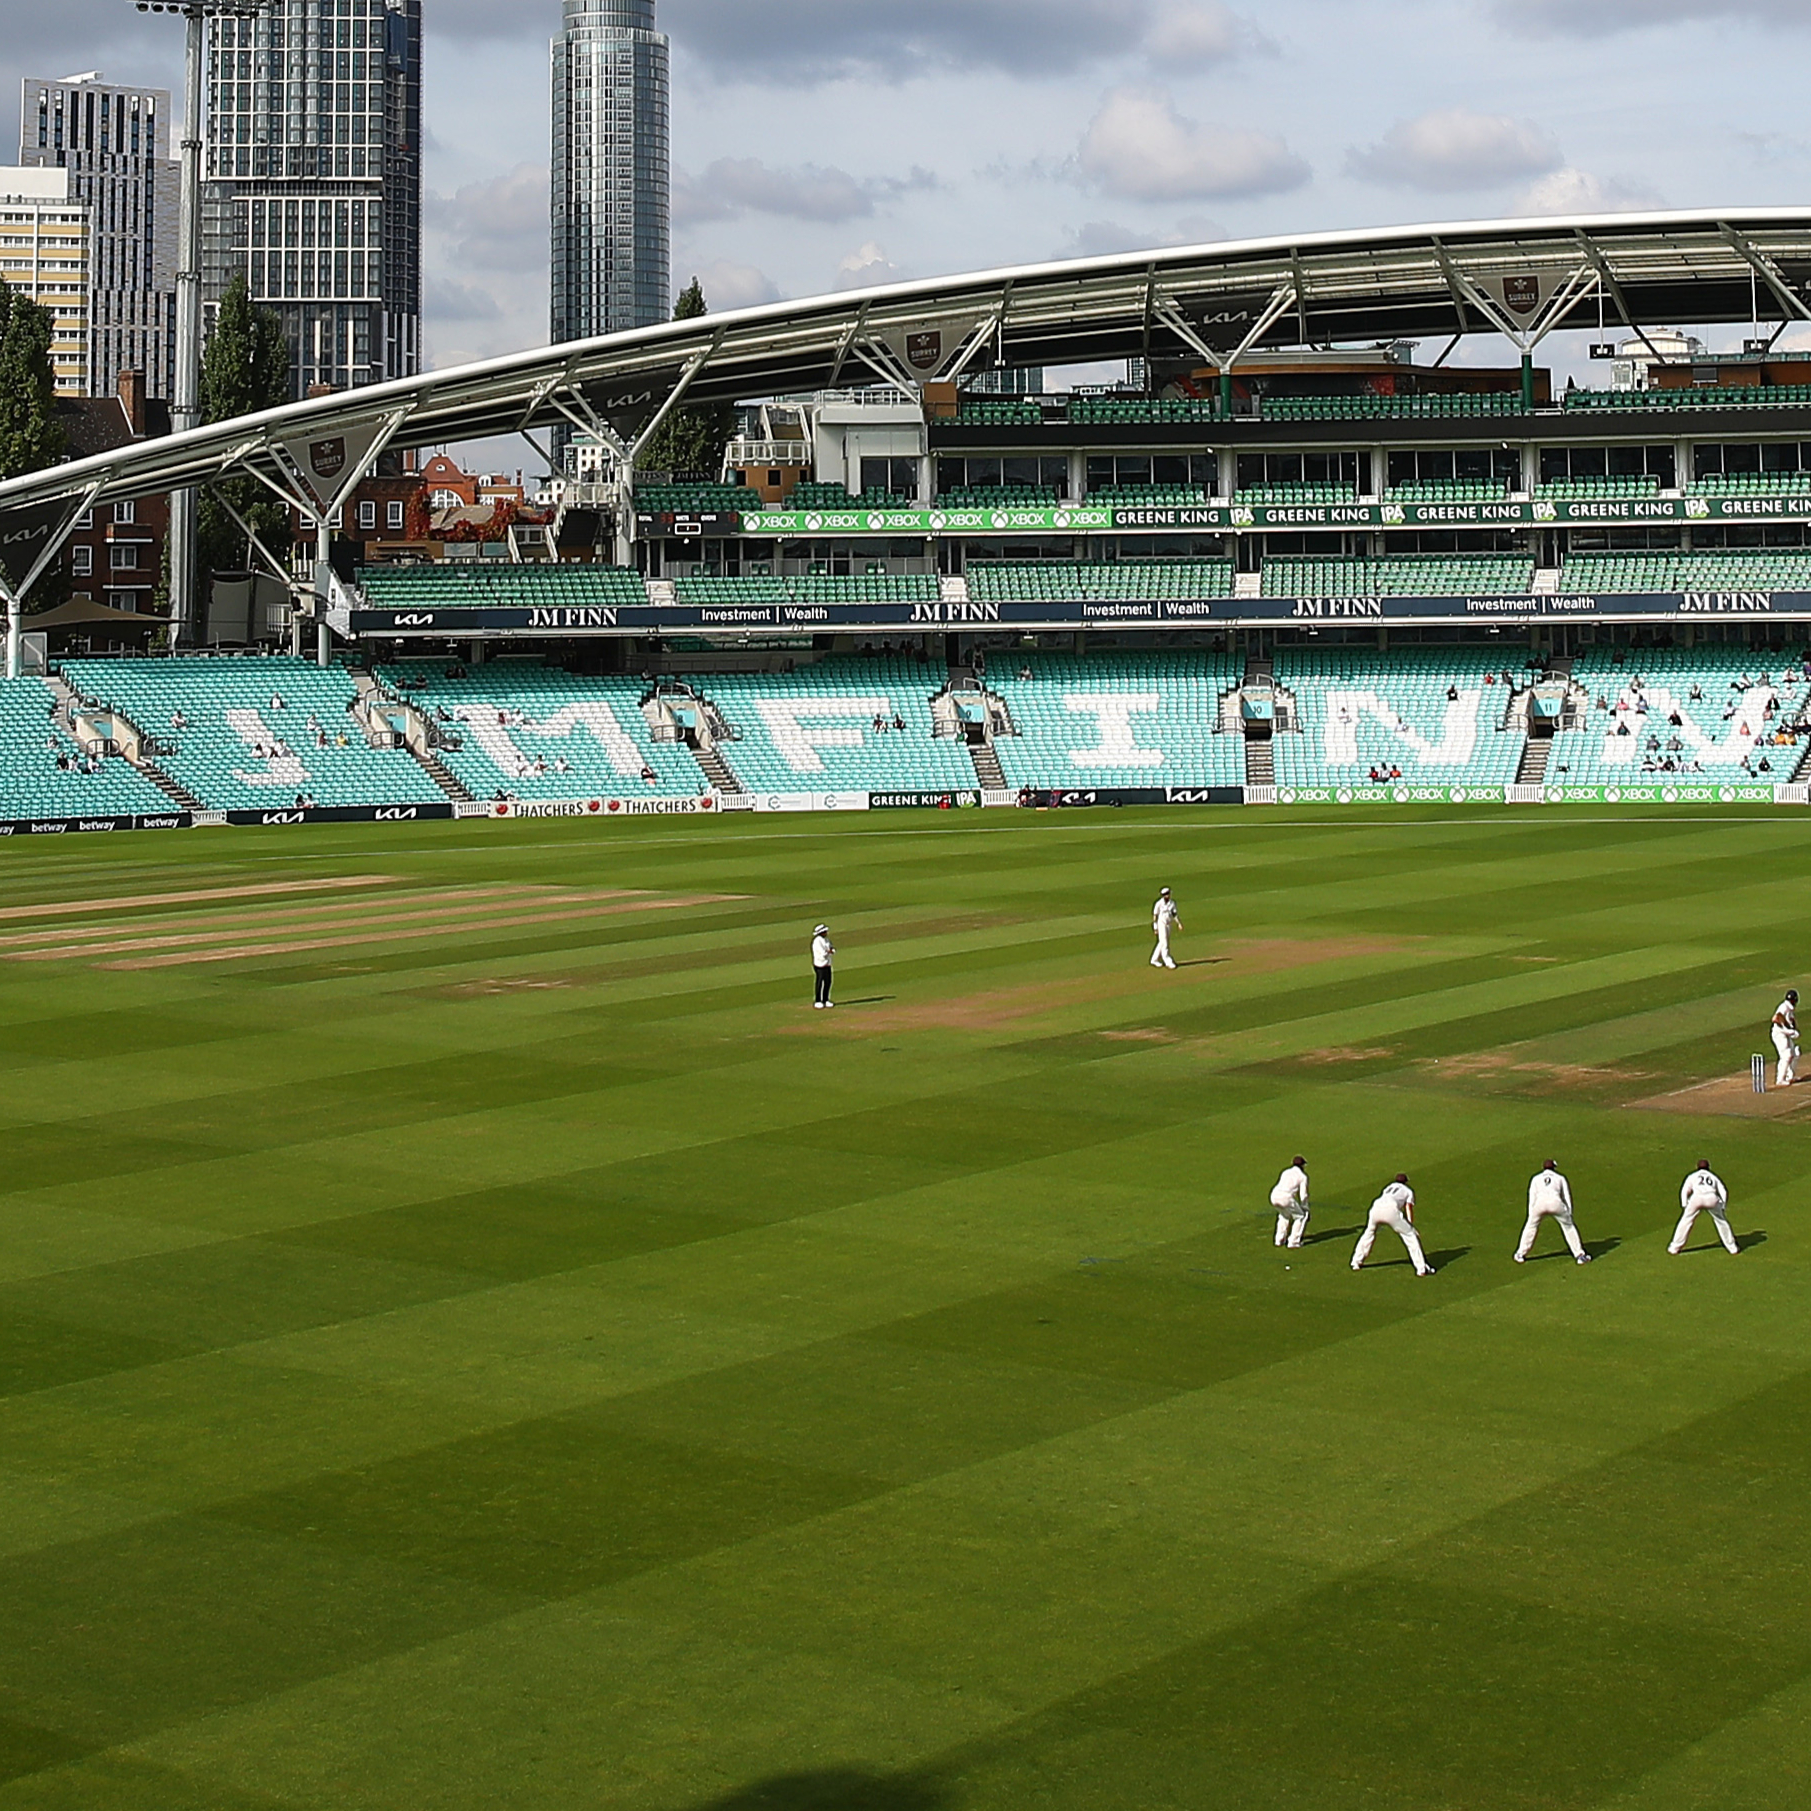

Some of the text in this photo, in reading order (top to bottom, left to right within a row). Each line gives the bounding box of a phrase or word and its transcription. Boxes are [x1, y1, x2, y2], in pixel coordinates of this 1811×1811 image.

[1508, 292, 1536, 301] SURREY
[1266, 506, 1405, 522] GREENE KING IPA
[1417, 502, 1557, 520] GREENE KING IPA
[1568, 500, 1710, 517] GREENE KING IPA
[1721, 501, 1784, 514] GREENE
[761, 516, 797, 528] XBOX
[824, 514, 859, 527] XBOX
[886, 514, 921, 527] XBOX
[948, 513, 983, 526] XBOX
[1010, 512, 1045, 525] XBOX
[1072, 512, 1107, 524] XBOX
[1116, 508, 1254, 524] GREENE KING IPA
[1083, 601, 1210, 616] Investment Wealth
[1292, 598, 1382, 617] JM FINN
[1466, 596, 1595, 611] Investment Wealth
[1679, 593, 1771, 611] JM FINN
[527, 608, 618, 628] JM FINN
[701, 607, 828, 621] Investment Wealth
[910, 602, 999, 622] JM FINN
[872, 795, 919, 806] GREENE
[1297, 788, 1331, 802] XBOX
[1354, 788, 1388, 802] XBOX
[1411, 788, 1445, 802] XBOX
[1466, 788, 1500, 802] XBOX
[1735, 788, 1770, 802] XBOX
[512, 802, 583, 817] THATCHERS
[624, 800, 696, 814] THATCHERS
[79, 818, 116, 832] betway
[143, 816, 179, 830] betway
[1543, 1175, 1552, 1187] 9
[1698, 1174, 1713, 1186] 26
